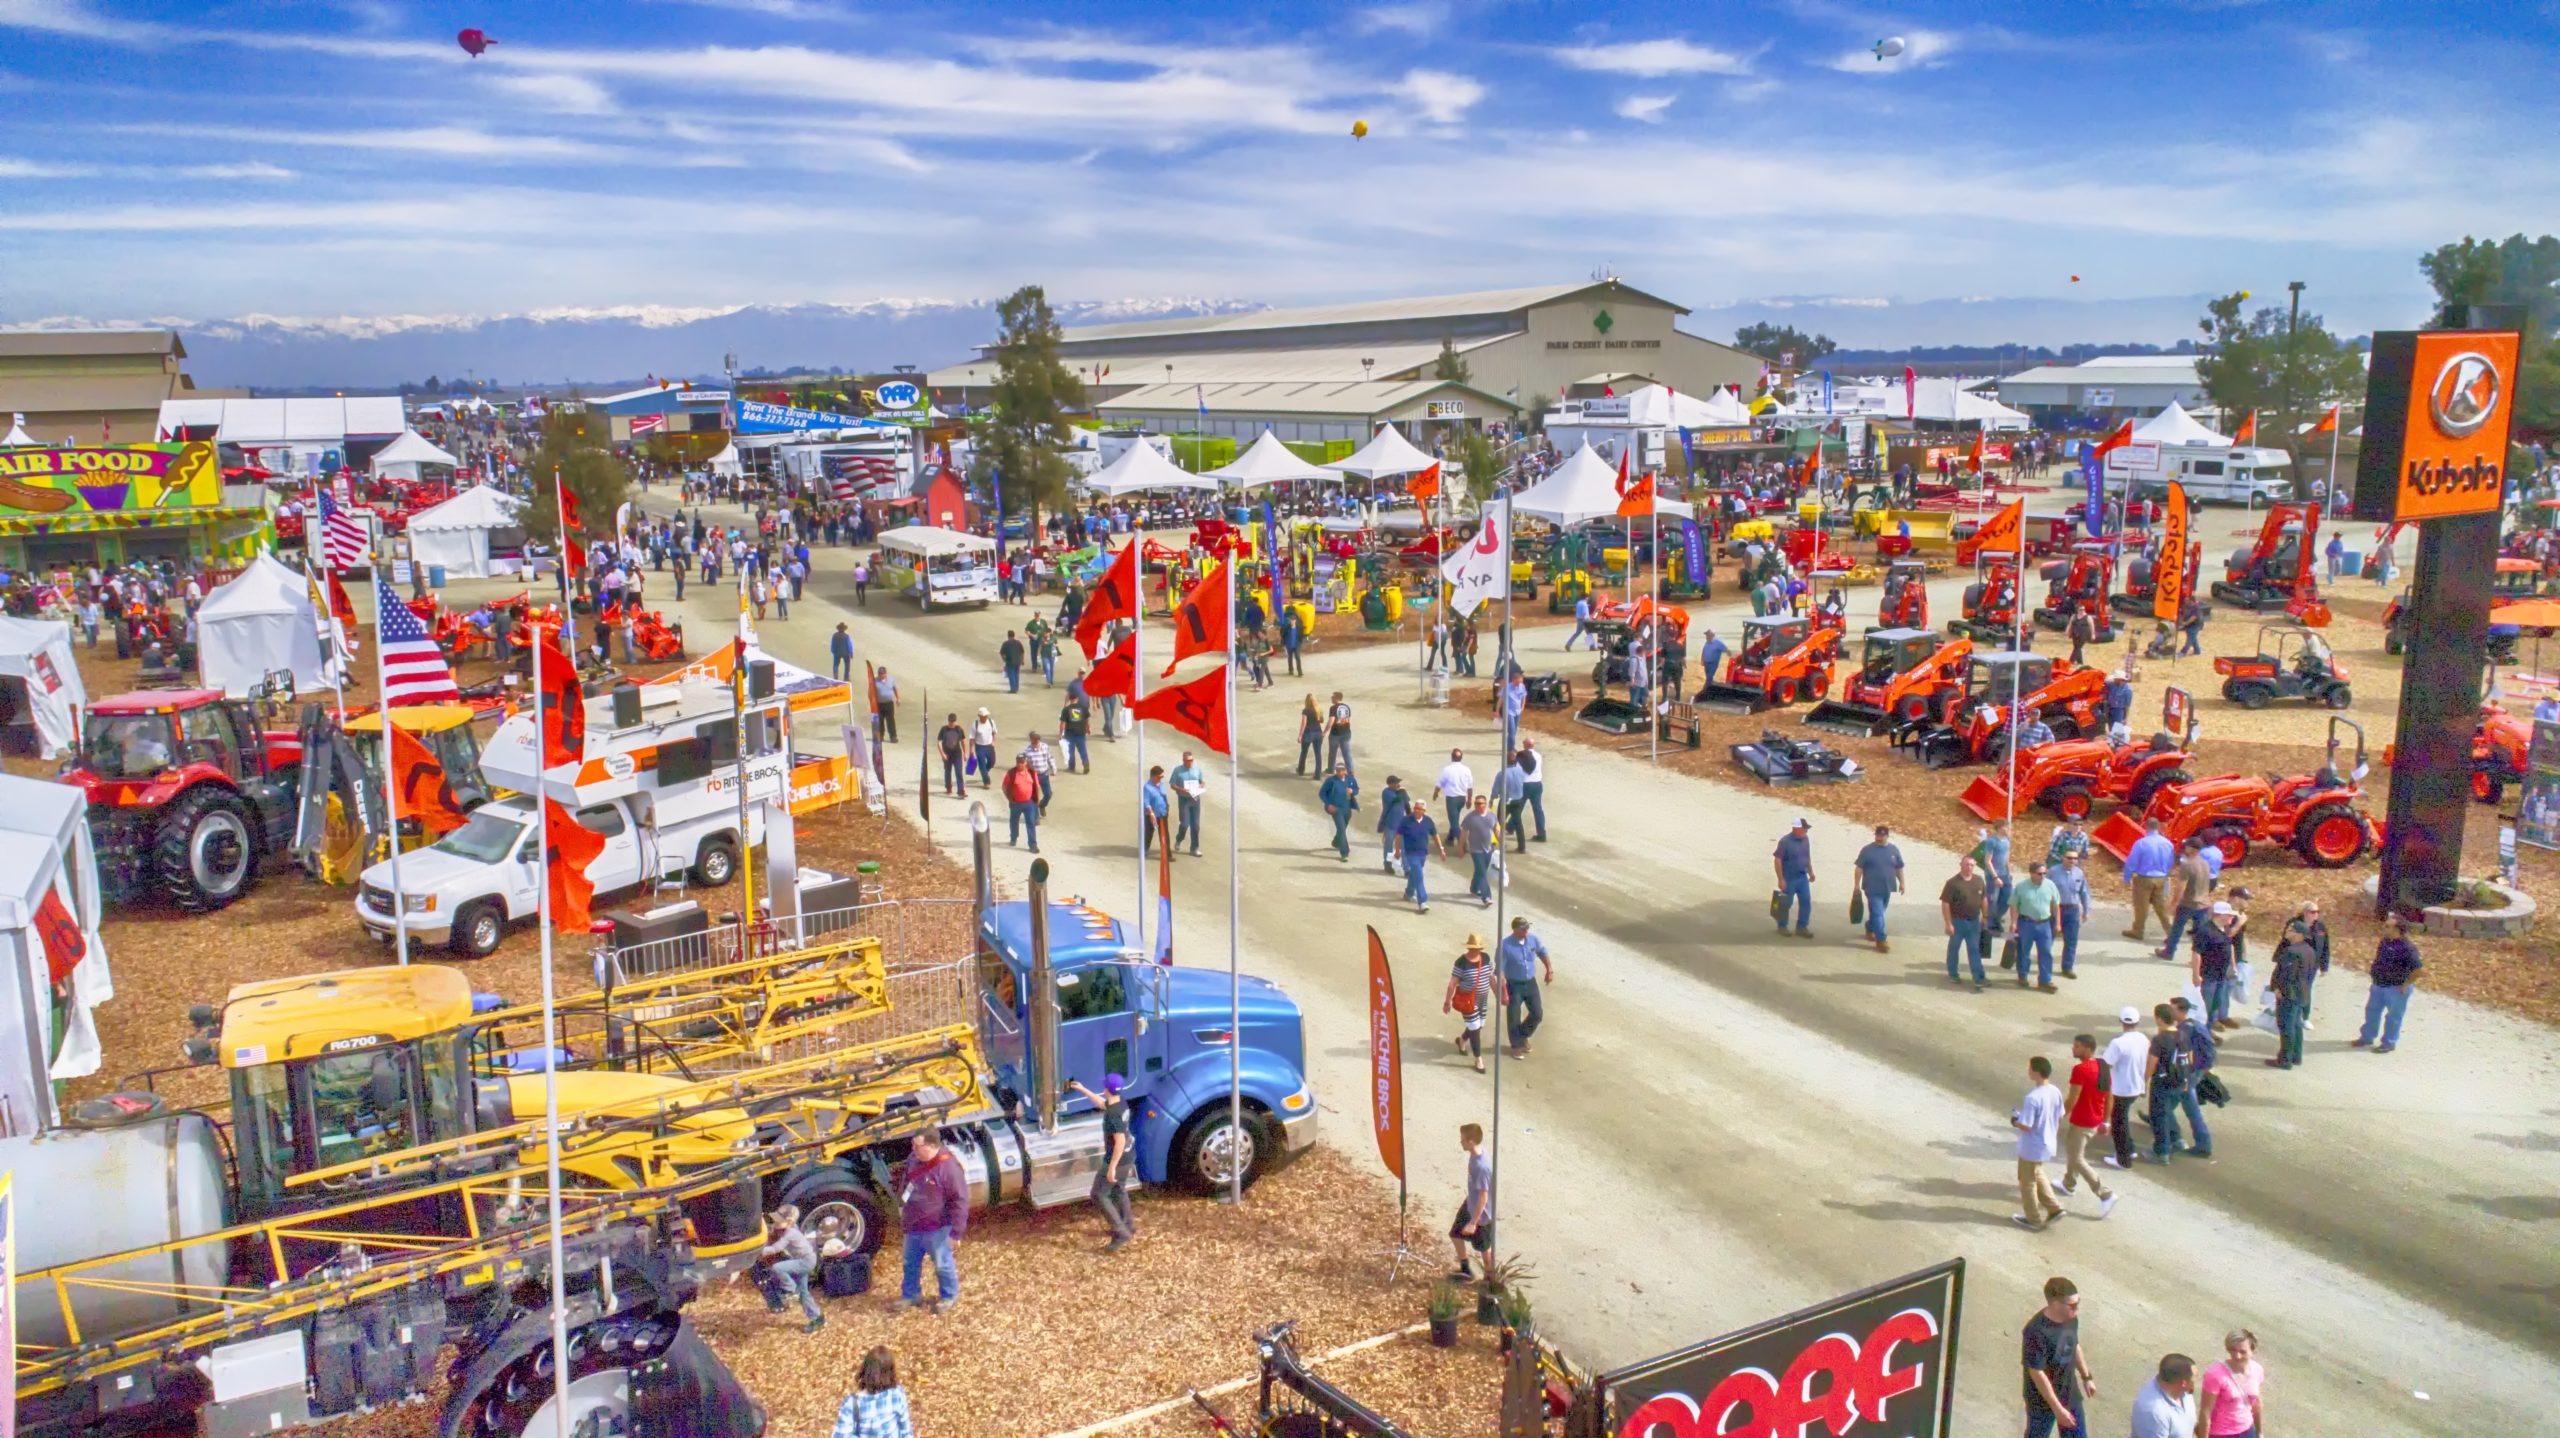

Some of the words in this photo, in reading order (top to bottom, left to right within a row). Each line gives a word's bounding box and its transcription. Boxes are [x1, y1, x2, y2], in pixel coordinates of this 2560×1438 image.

[1547, 341, 1569, 349] FARM
[1573, 341, 1601, 349] CREDIT
[1631, 340, 1661, 348] CENTER
[880, 384, 916, 404] PAR
[743, 402, 764, 413] Rent
[768, 405, 785, 415] The
[786, 408, 817, 420] Brands
[820, 414, 836, 423] You
[839, 416, 863, 426] Trust!
[1438, 402, 1463, 414] BECO
[1702, 431, 1737, 444] SHERIFF'S
[60, 452, 152, 471] FOOD
[2408, 454, 2498, 495] Kubota
[811, 778, 841, 797] BROS.
[353, 779, 371, 834] DEERE
